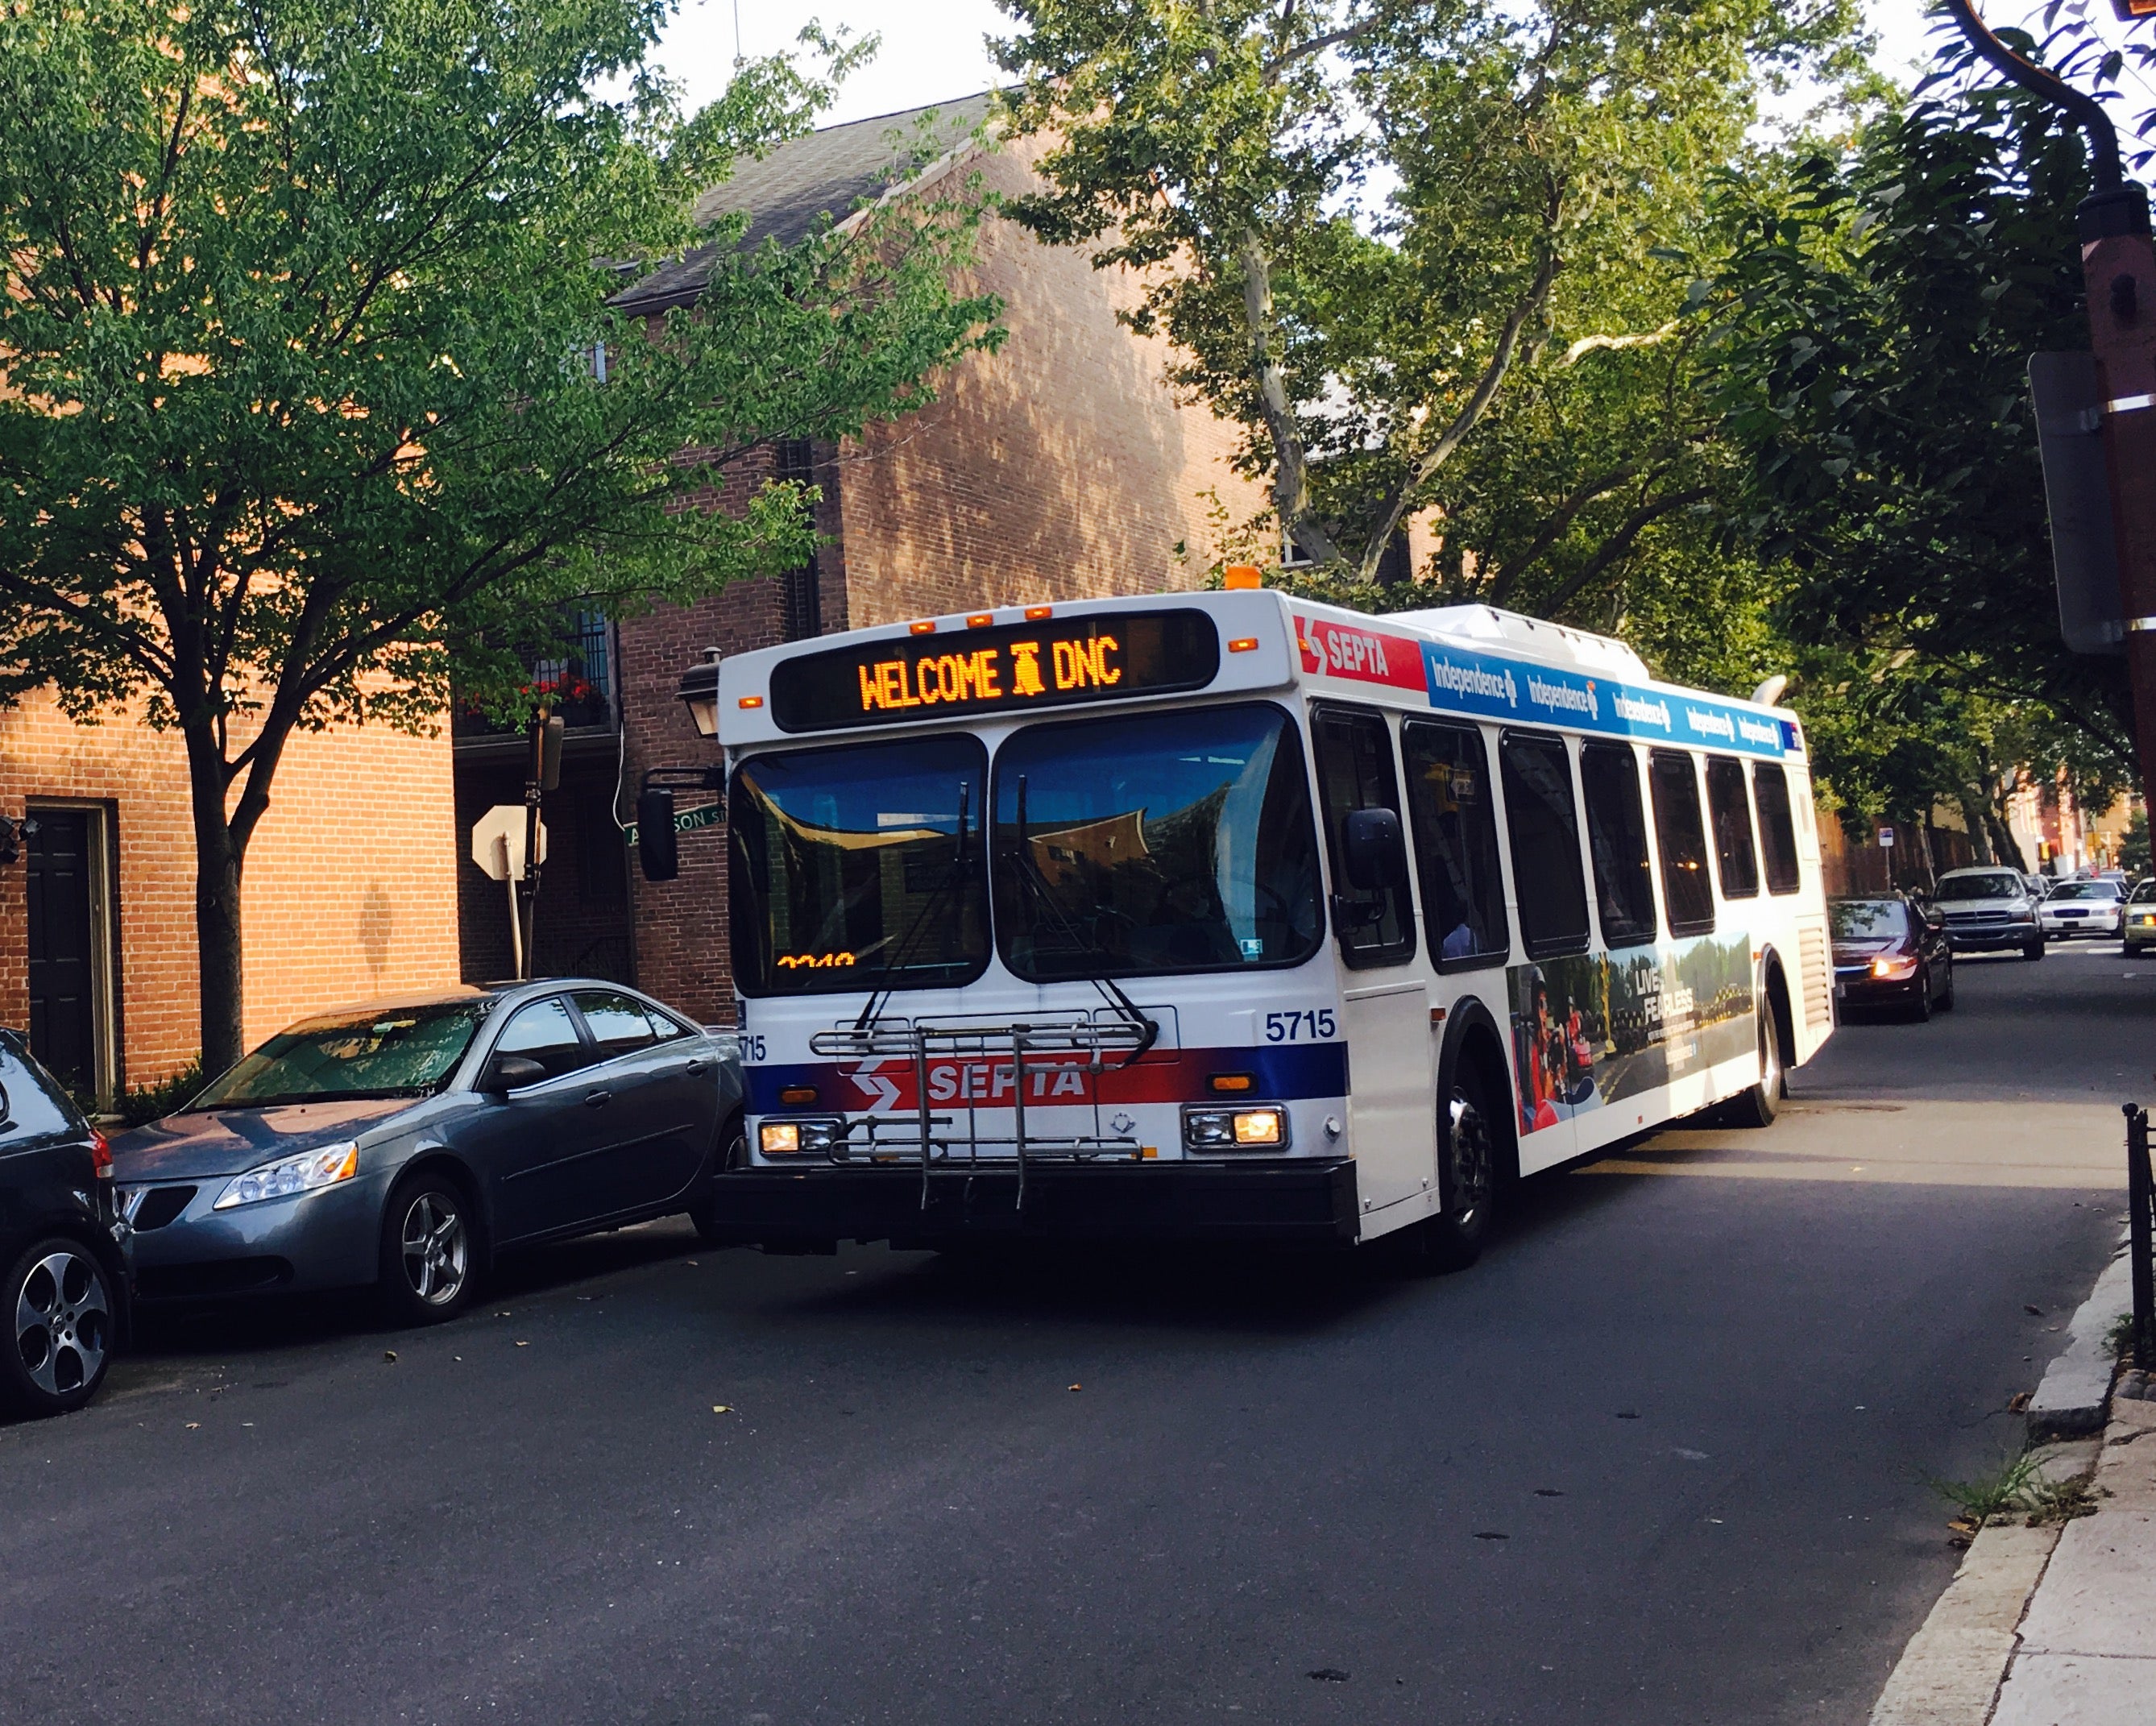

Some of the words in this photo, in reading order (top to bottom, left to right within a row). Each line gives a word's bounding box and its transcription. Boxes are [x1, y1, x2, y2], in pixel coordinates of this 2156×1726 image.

[1327, 630, 1389, 676] SEPTA
[859, 649, 1001, 710] WELCOME
[1053, 637, 1121, 689] DNC
[1431, 656, 1505, 699] Independence
[1528, 674, 1588, 713] Independence
[1636, 967, 1659, 996] LIVE
[1266, 1009, 1335, 1042] 5715
[1644, 988, 1693, 1026] FEARLESS
[739, 1035, 766, 1061] 715
[928, 1061, 1084, 1101] SEPTA
